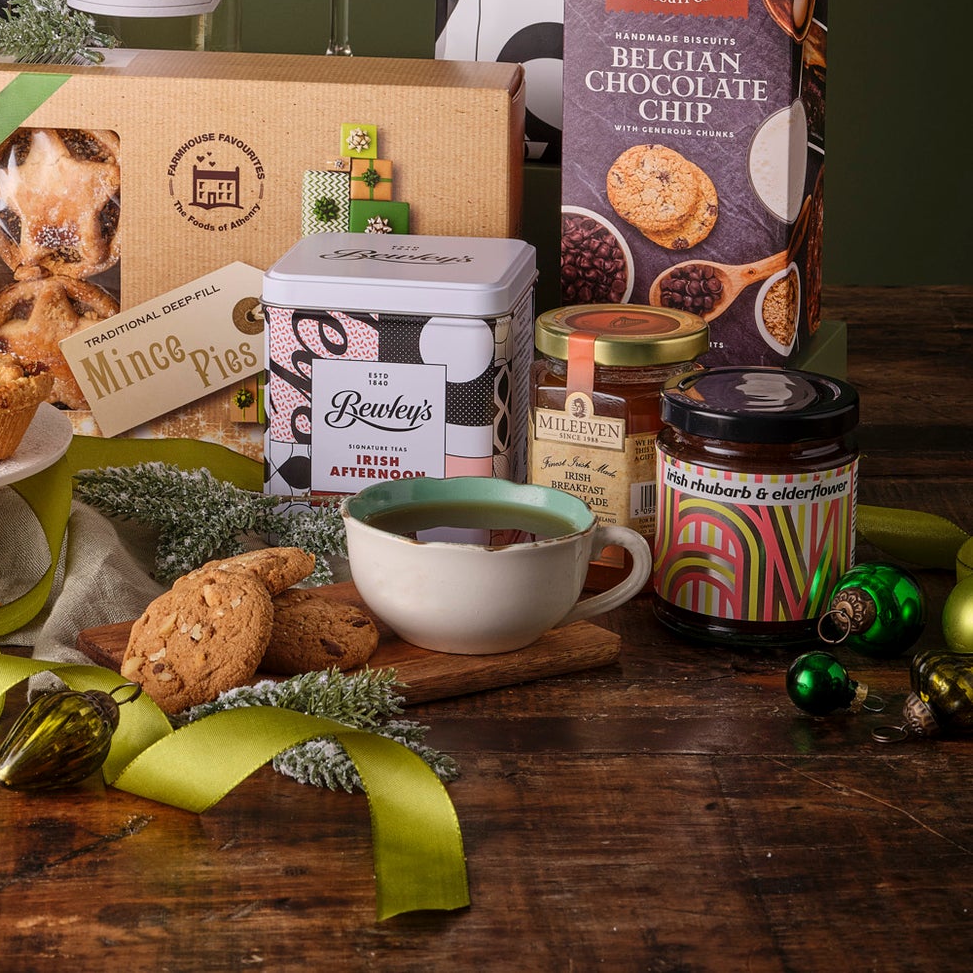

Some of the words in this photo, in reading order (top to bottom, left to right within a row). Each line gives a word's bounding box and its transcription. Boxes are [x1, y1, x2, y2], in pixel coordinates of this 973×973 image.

[615, 32, 679, 44] HANDMADE
[683, 35, 737, 46] BISCUITS
[610, 46, 742, 74] BELGIAN
[585, 70, 768, 102] CHOCOLATE
[638, 98, 713, 124] CHIP
[614, 124, 638, 133] WITH
[642, 126, 692, 137] GENEROUS
[696, 129, 735, 138] CHUNKS
[167, 133, 215, 176] FARMHOUSE
[218, 133, 265, 180] FAVOURITES
[173, 200, 187, 217] The
[187, 215, 215, 232] Foods
[218, 223, 228, 232] of
[230, 203, 261, 230] Athenry
[319, 248, 474, 266] Bewley's
[84, 311, 161, 348] TRADITIONAL
[161, 284, 221, 315] DEEP-FILL
[79, 335, 186, 400] Mince
[188, 342, 258, 389] Pies
[324, 390, 433, 432] Bewley's
[539, 414, 620, 439] MILEEVEN
[559, 432, 580, 441] SINCE
[348, 444, 388, 452] SIGNATURE
[356, 454, 400, 467] IRISH
[541, 455, 567, 469] Finest
[567, 456, 591, 469] Irish
[551, 480, 606, 496] BREAKFAST
[565, 471, 591, 483] IRISH
[666, 468, 688, 487] irish
[691, 479, 752, 499] rhubarb
[756, 488, 769, 500] &
[772, 481, 848, 501] elderflower
